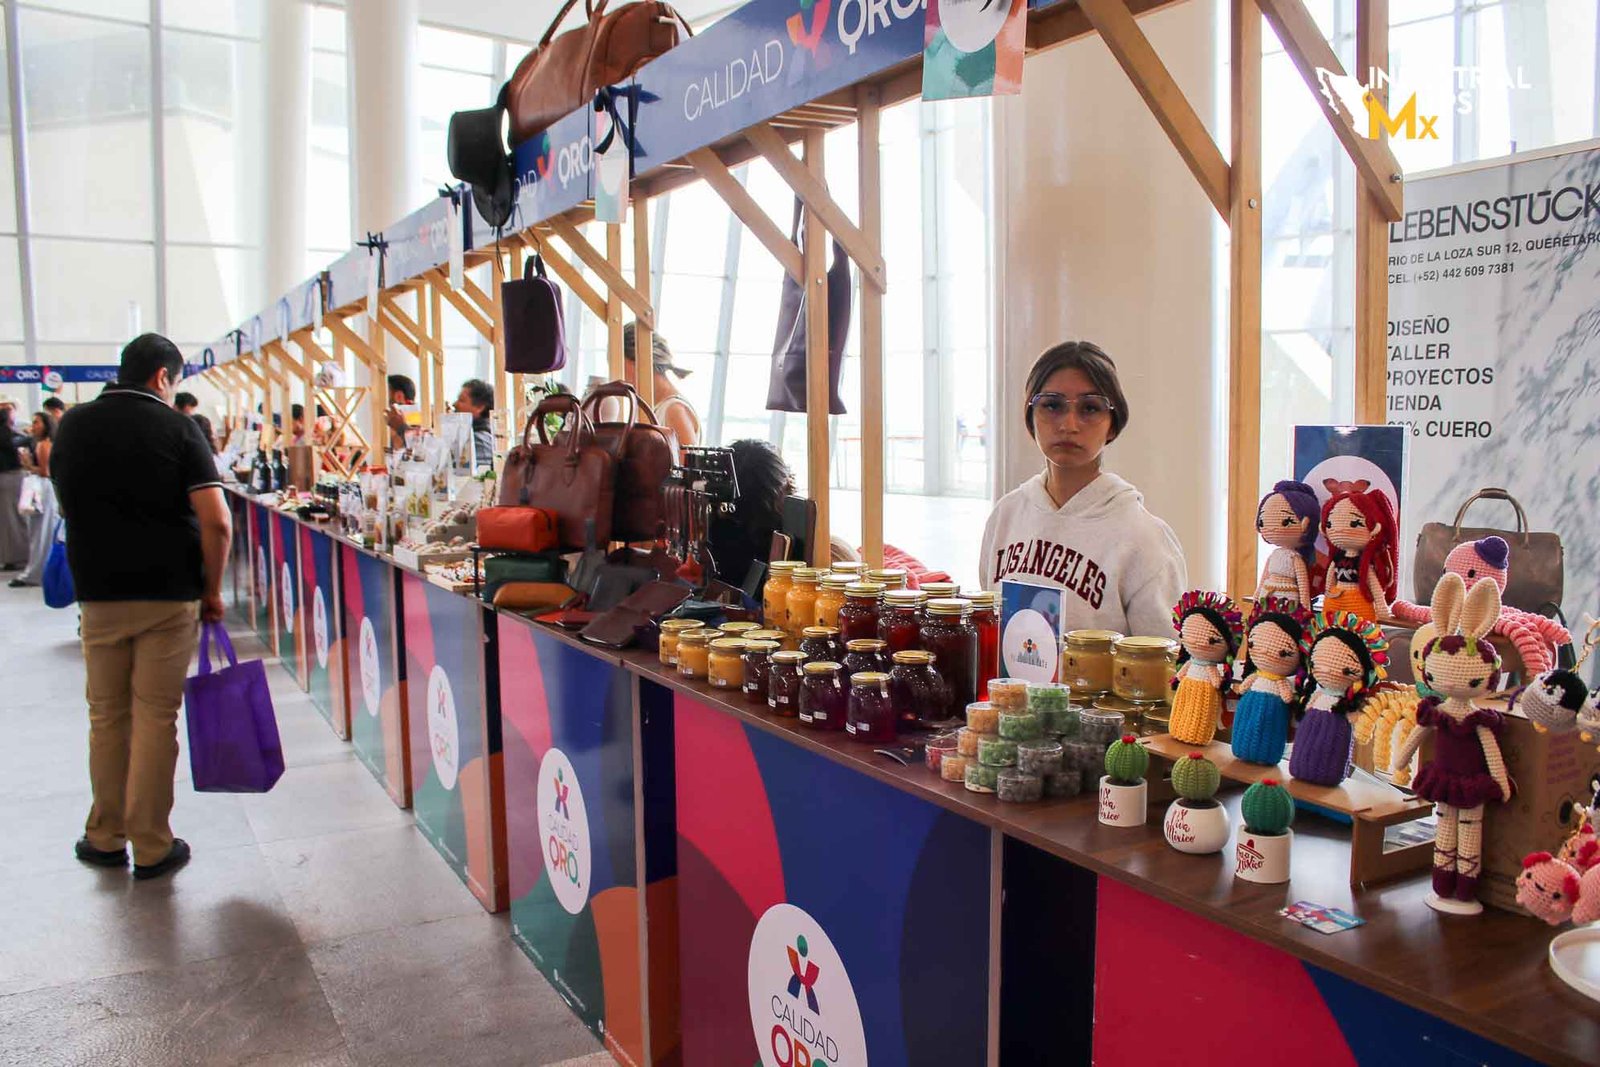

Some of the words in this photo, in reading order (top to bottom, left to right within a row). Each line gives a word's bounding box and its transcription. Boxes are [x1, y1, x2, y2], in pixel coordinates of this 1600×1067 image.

[684, 40, 784, 121] CALIDAD
[1410, 253, 1425, 265] DE
[1427, 251, 1441, 262] LA
[1444, 247, 1474, 261] LOZA
[1477, 244, 1502, 257] SUR
[1505, 242, 1522, 254] 12,
[1413, 269, 1440, 284] (+52)
[1442, 268, 1462, 279] 442
[1464, 265, 1485, 277] 609
[1488, 262, 1515, 275] 7381
[1386, 394, 1442, 411] IENDA
[1425, 420, 1493, 438] CUERO
[771, 994, 839, 1063] CALIDAD
